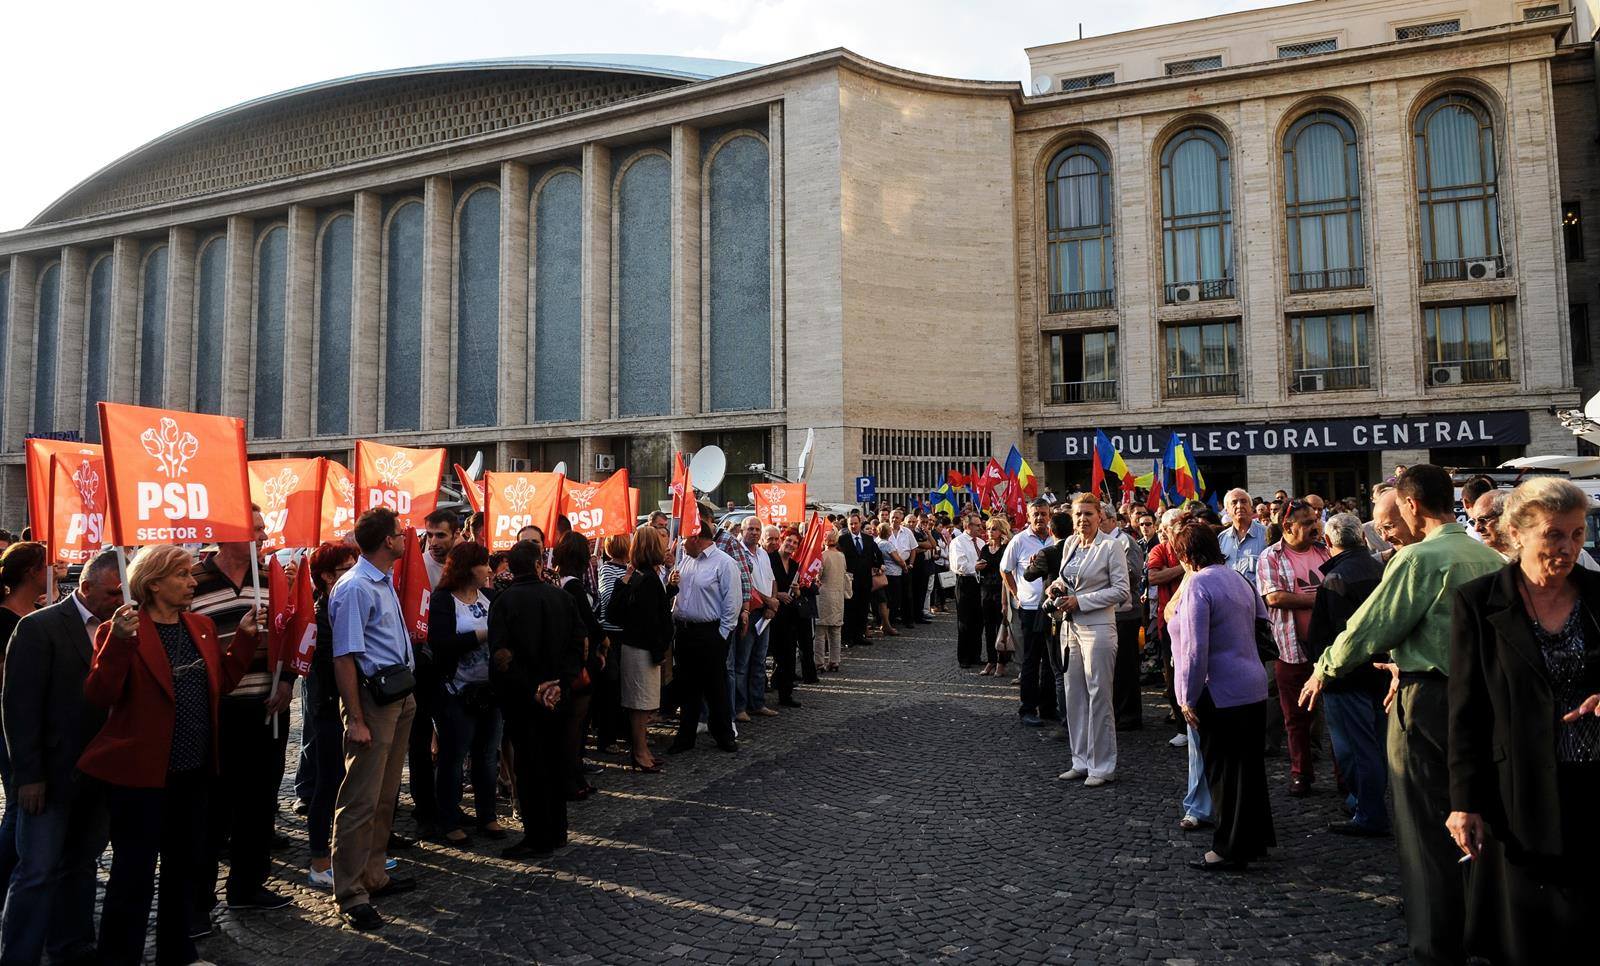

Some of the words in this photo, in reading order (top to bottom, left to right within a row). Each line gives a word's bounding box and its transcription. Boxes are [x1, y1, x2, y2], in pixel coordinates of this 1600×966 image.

[1065, 434, 1160, 455] BIOUL
[1352, 420, 1494, 446] CENTRAL
[860, 478, 871, 494] P
[138, 481, 209, 520] PSD
[369, 488, 411, 515] PSD
[567, 508, 604, 530] PSD
[770, 504, 788, 517] SD
[137, 527, 197, 540] SECTOR
[204, 527, 214, 538] 3
[279, 536, 286, 545] 3
